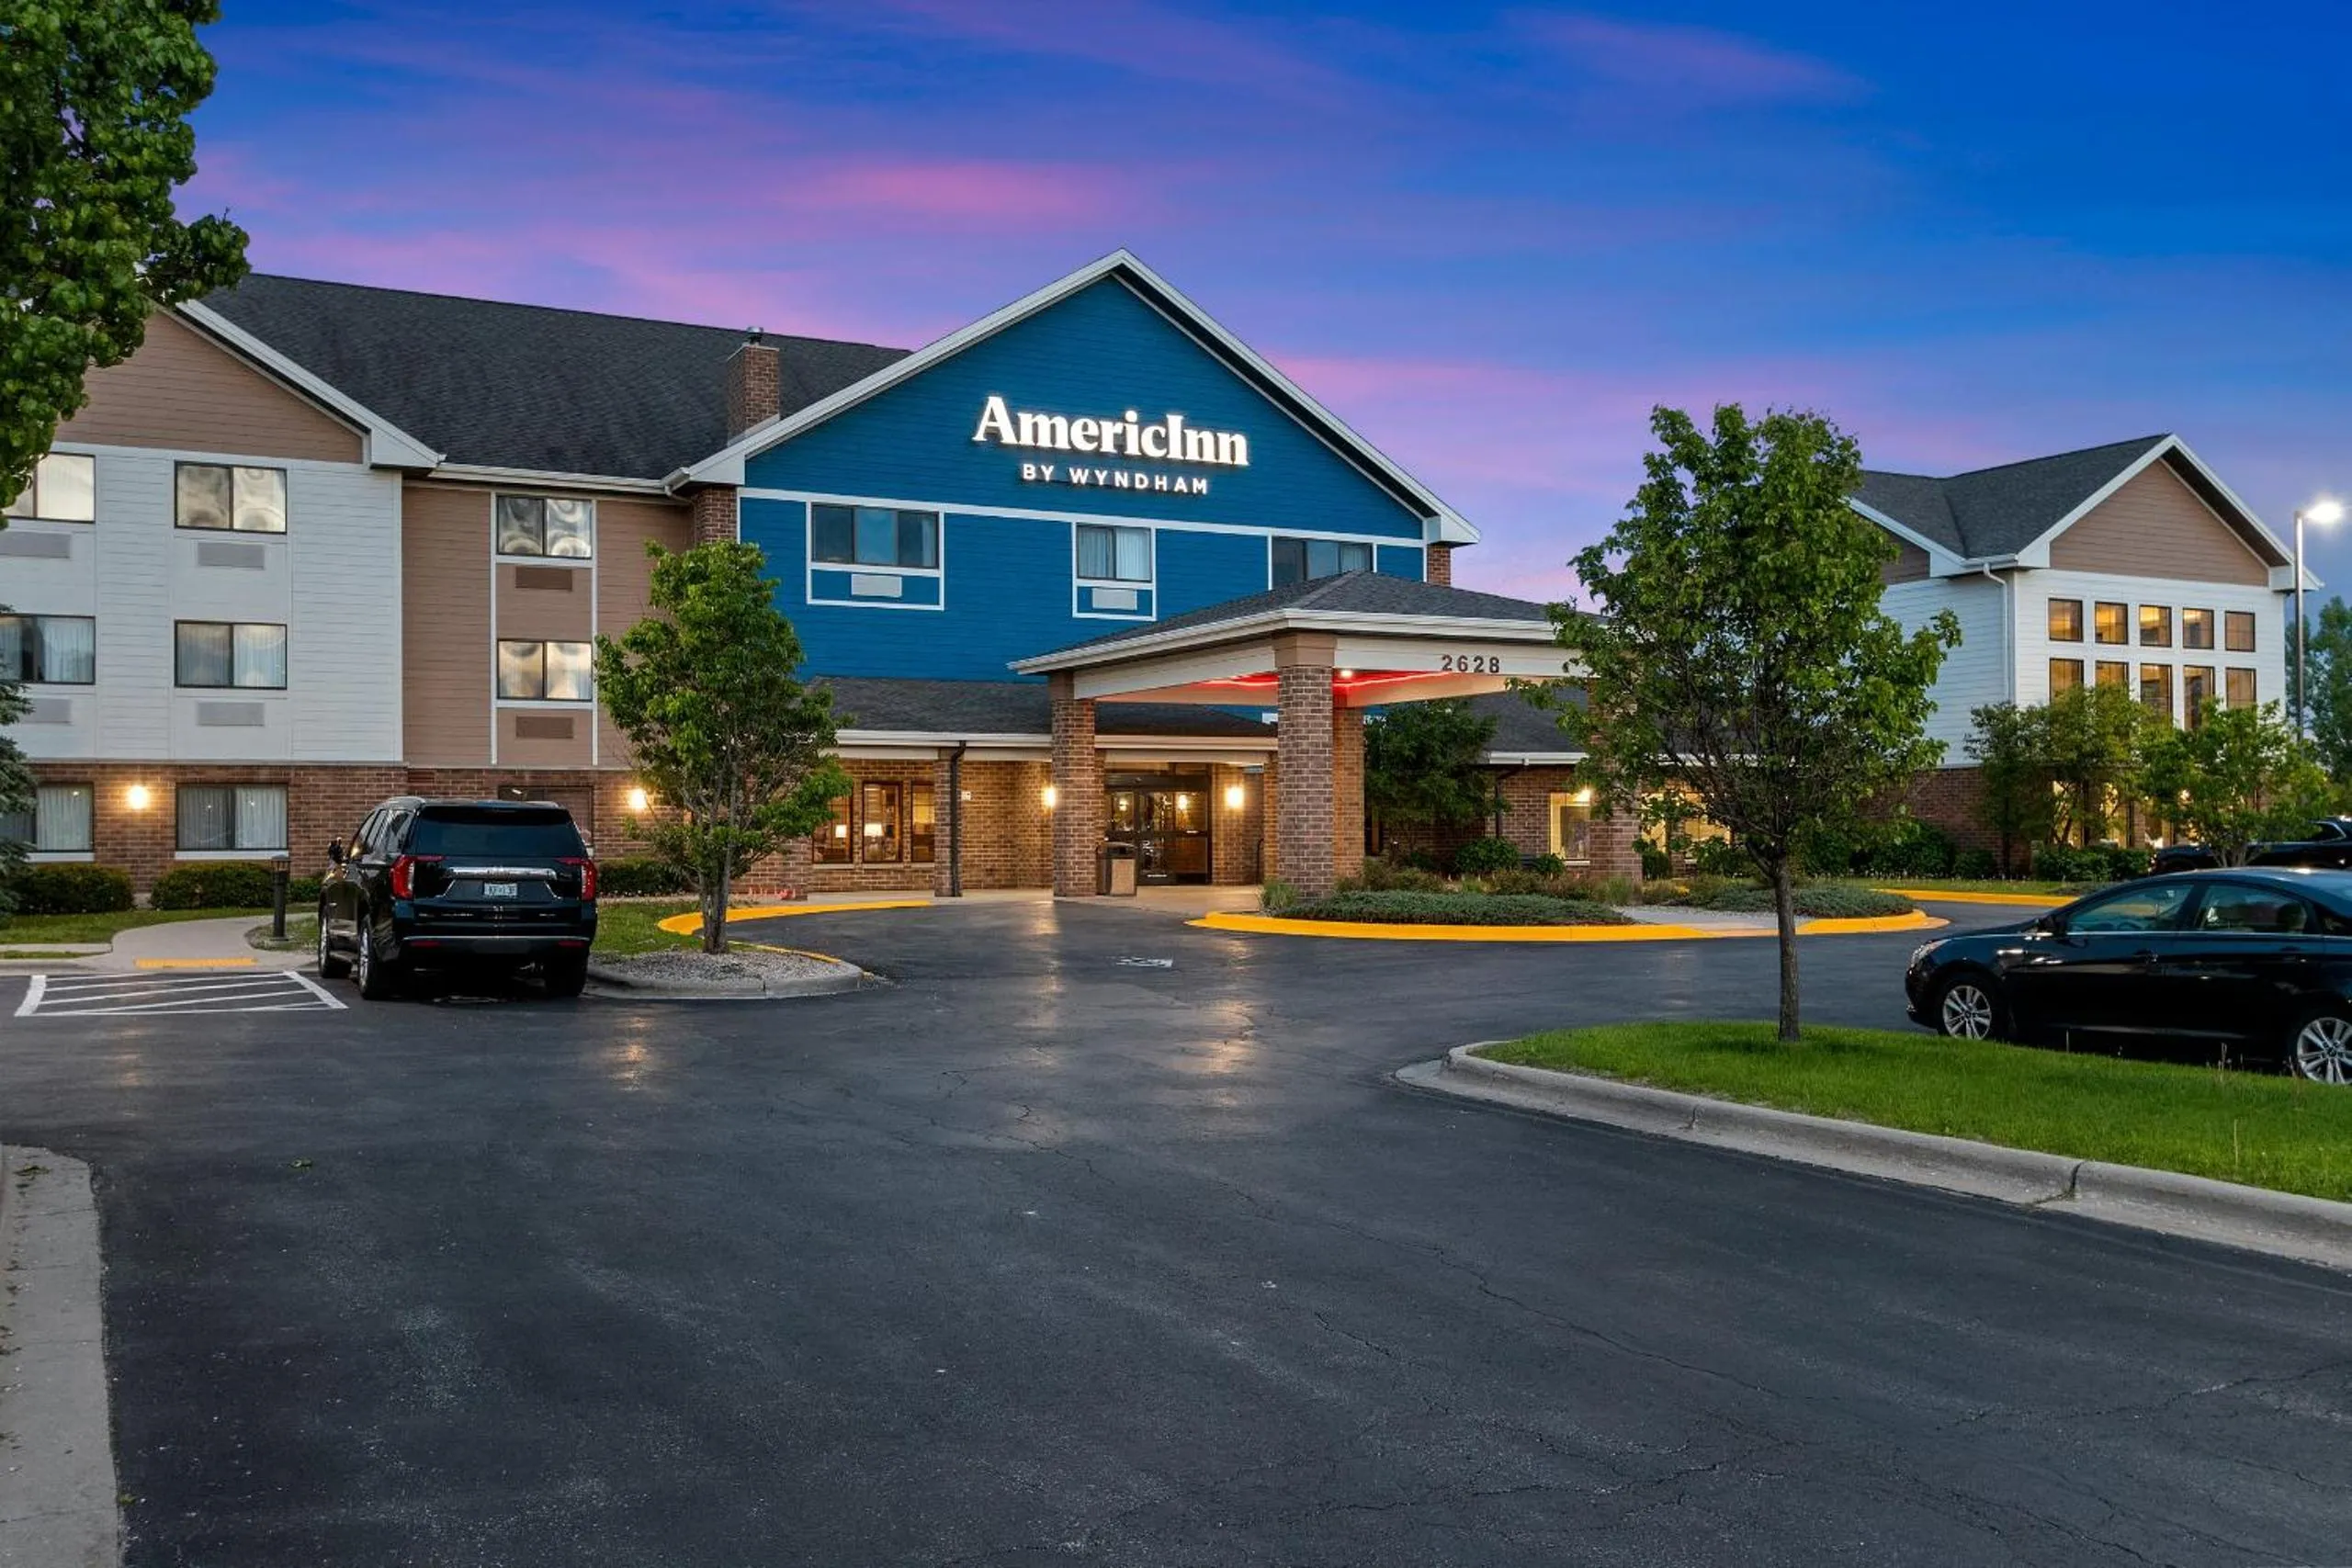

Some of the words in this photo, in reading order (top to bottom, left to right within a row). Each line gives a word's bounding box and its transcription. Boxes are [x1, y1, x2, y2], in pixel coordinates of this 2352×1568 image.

[972, 395, 1250, 466] AmericInn
[1023, 463, 1054, 481] BY
[1069, 466, 1207, 494] WYNDHAM
[1442, 654, 1500, 673] 2628
